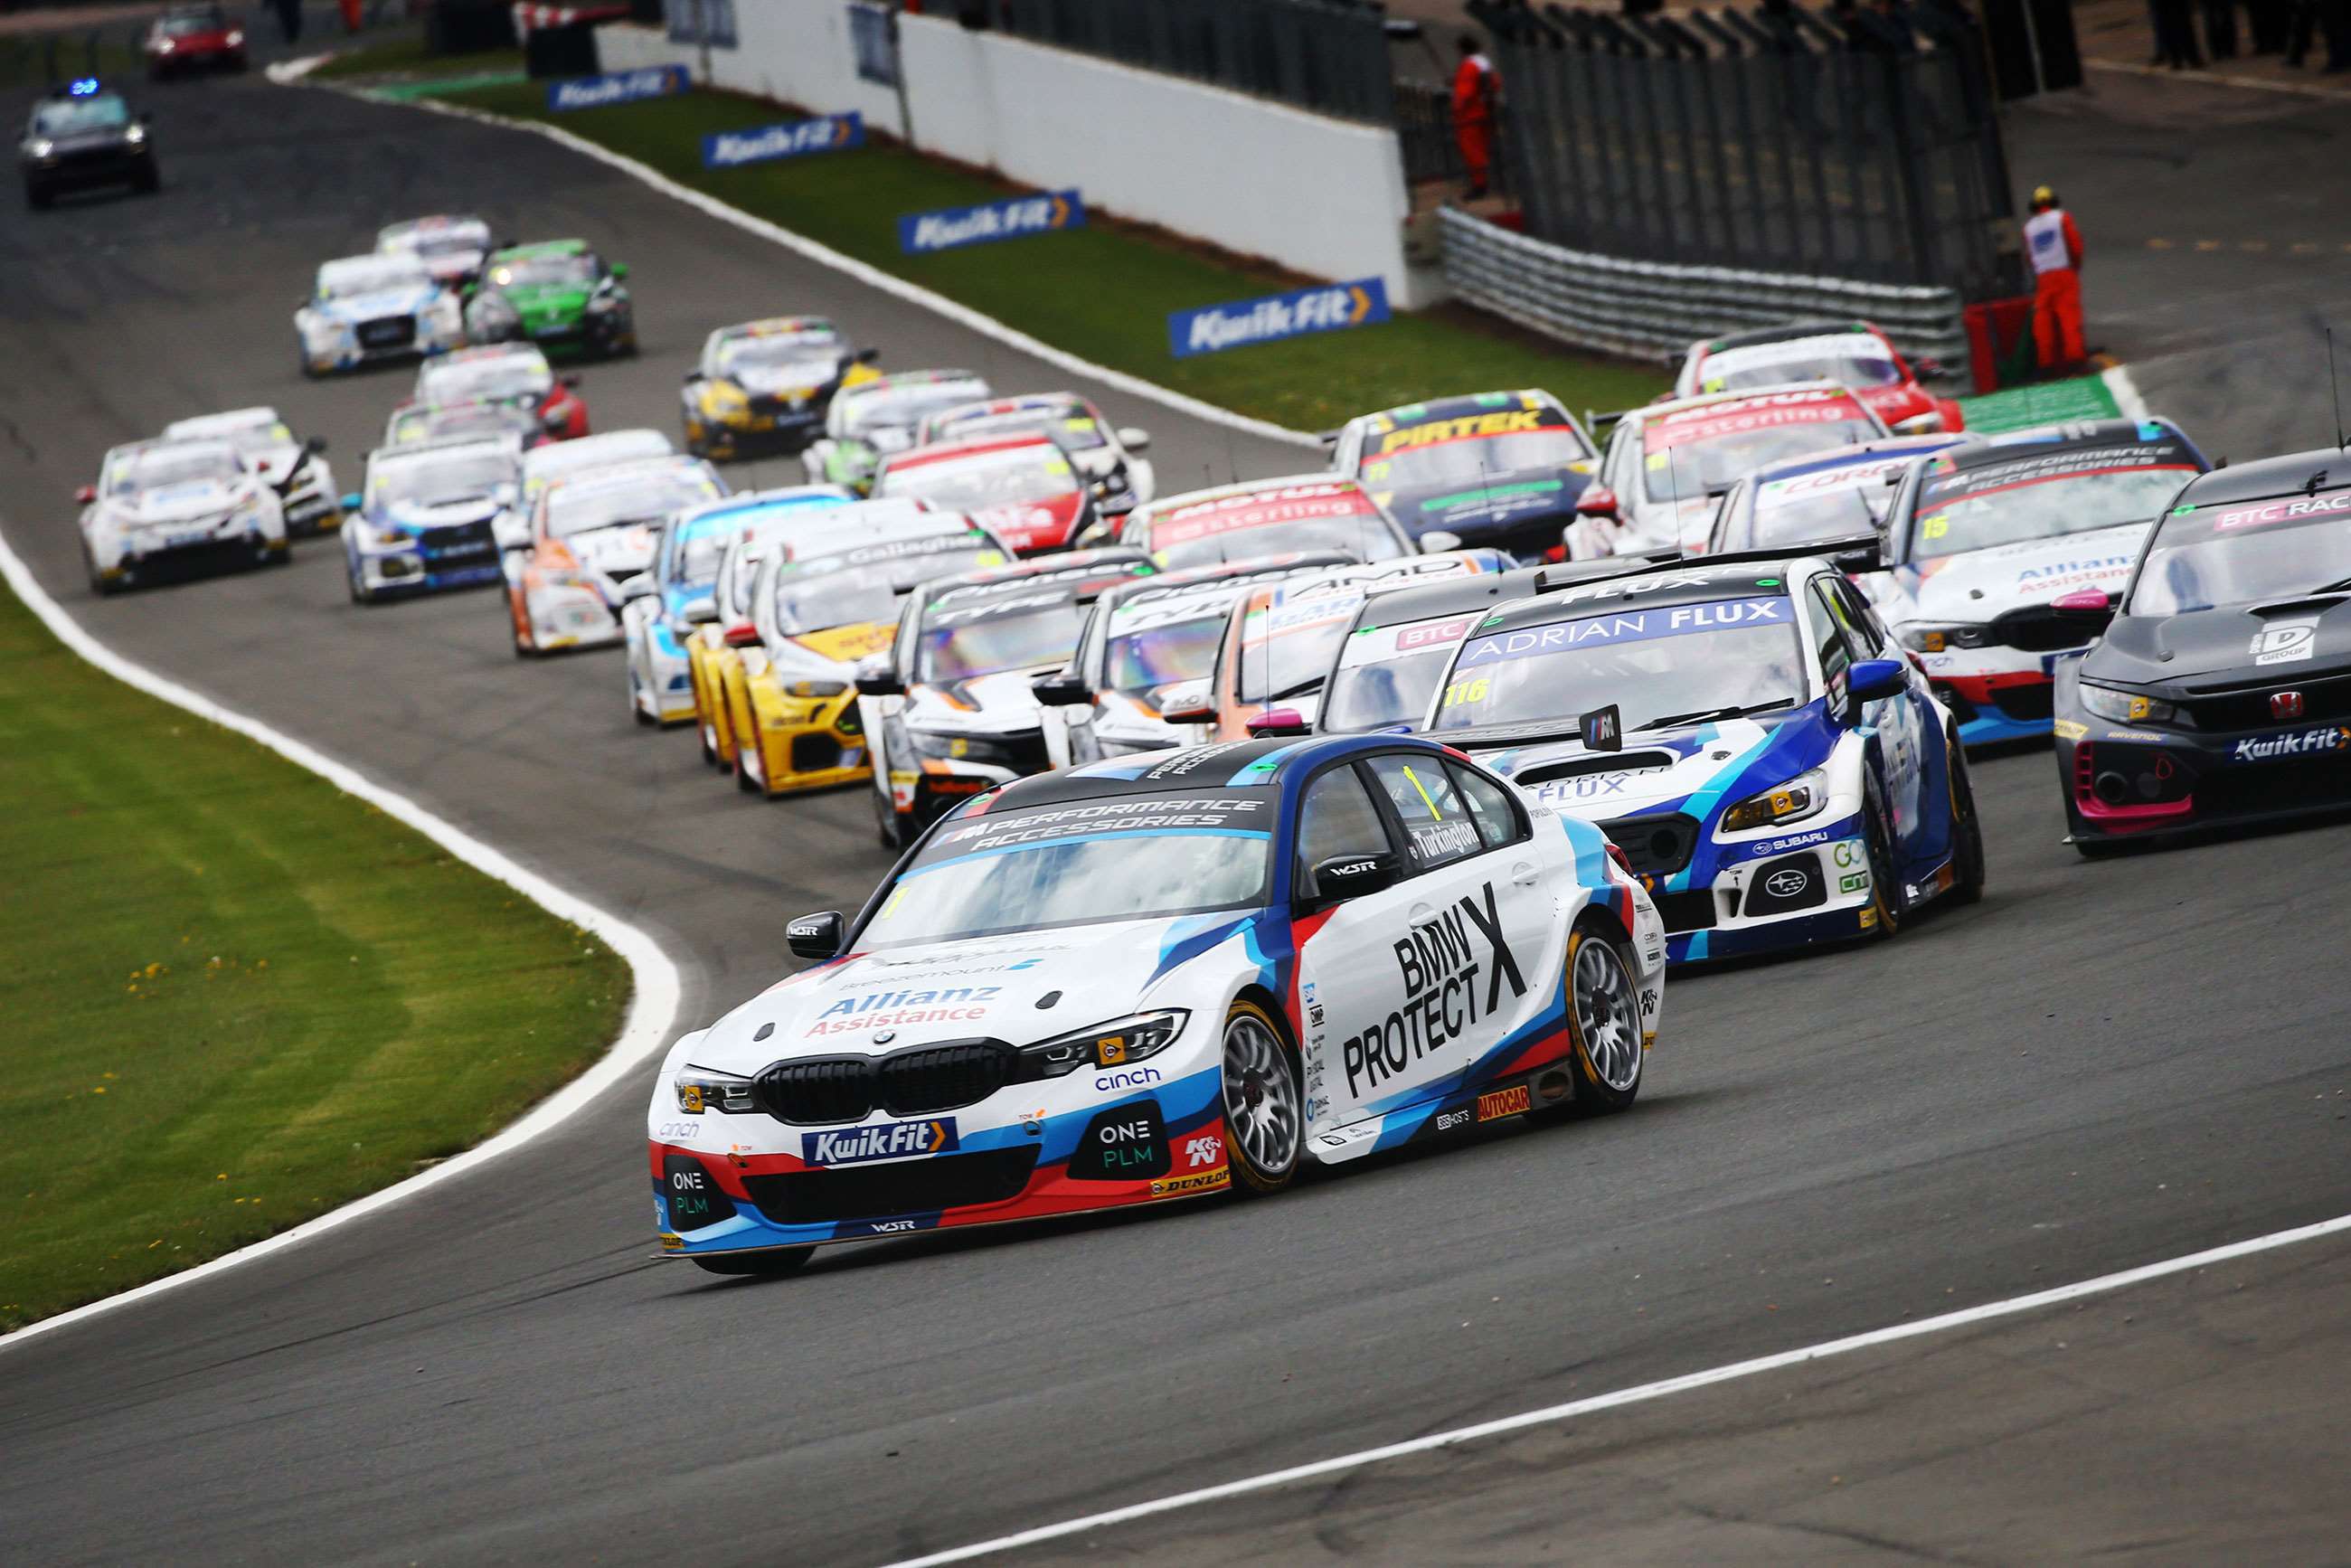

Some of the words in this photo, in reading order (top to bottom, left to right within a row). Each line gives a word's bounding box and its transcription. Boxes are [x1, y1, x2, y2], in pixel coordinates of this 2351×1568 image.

[1664, 391, 1832, 425] MOTUL
[1381, 409, 1542, 454] PIRTEK
[1966, 455, 2157, 493] ACCESSORIES
[1969, 446, 2176, 482] PERFORMANCE
[1172, 484, 1344, 520] MOTUL
[2221, 506, 2279, 528] BTC
[2288, 496, 2351, 516] RAC
[1922, 515, 1950, 540] 15
[1560, 576, 1711, 606] FLUX
[1404, 621, 1463, 647] BTC
[1468, 613, 1645, 663] ADRIAN
[1670, 600, 1780, 629] FLUX
[1444, 678, 1490, 710] 116
[1402, 765, 1442, 822] 1
[1537, 777, 1629, 805] FLUX
[986, 798, 1266, 835] PERFORMANCE
[969, 814, 1229, 853] ACCESSORIES
[1413, 821, 1480, 859] Turkington
[1772, 831, 1829, 851] SUBARU
[1329, 860, 1378, 877] WSR
[882, 886, 910, 920] 1
[1393, 904, 1473, 999] BMW
[1459, 881, 1528, 1016] X
[817, 986, 1004, 1020] Allianz
[803, 1006, 987, 1039] Assistance
[1343, 961, 1479, 1100] PROTECT
[1095, 1067, 1162, 1091] cinch
[1478, 1087, 1530, 1120] AUTOCAR
[658, 1120, 700, 1138] cinch
[1100, 1119, 1151, 1144] ONE
[1102, 1144, 1155, 1168] PLM
[1185, 1136, 1222, 1167] K&N
[673, 1172, 704, 1190] ONE
[675, 1196, 709, 1214] PLM
[870, 1220, 916, 1233] WSR
